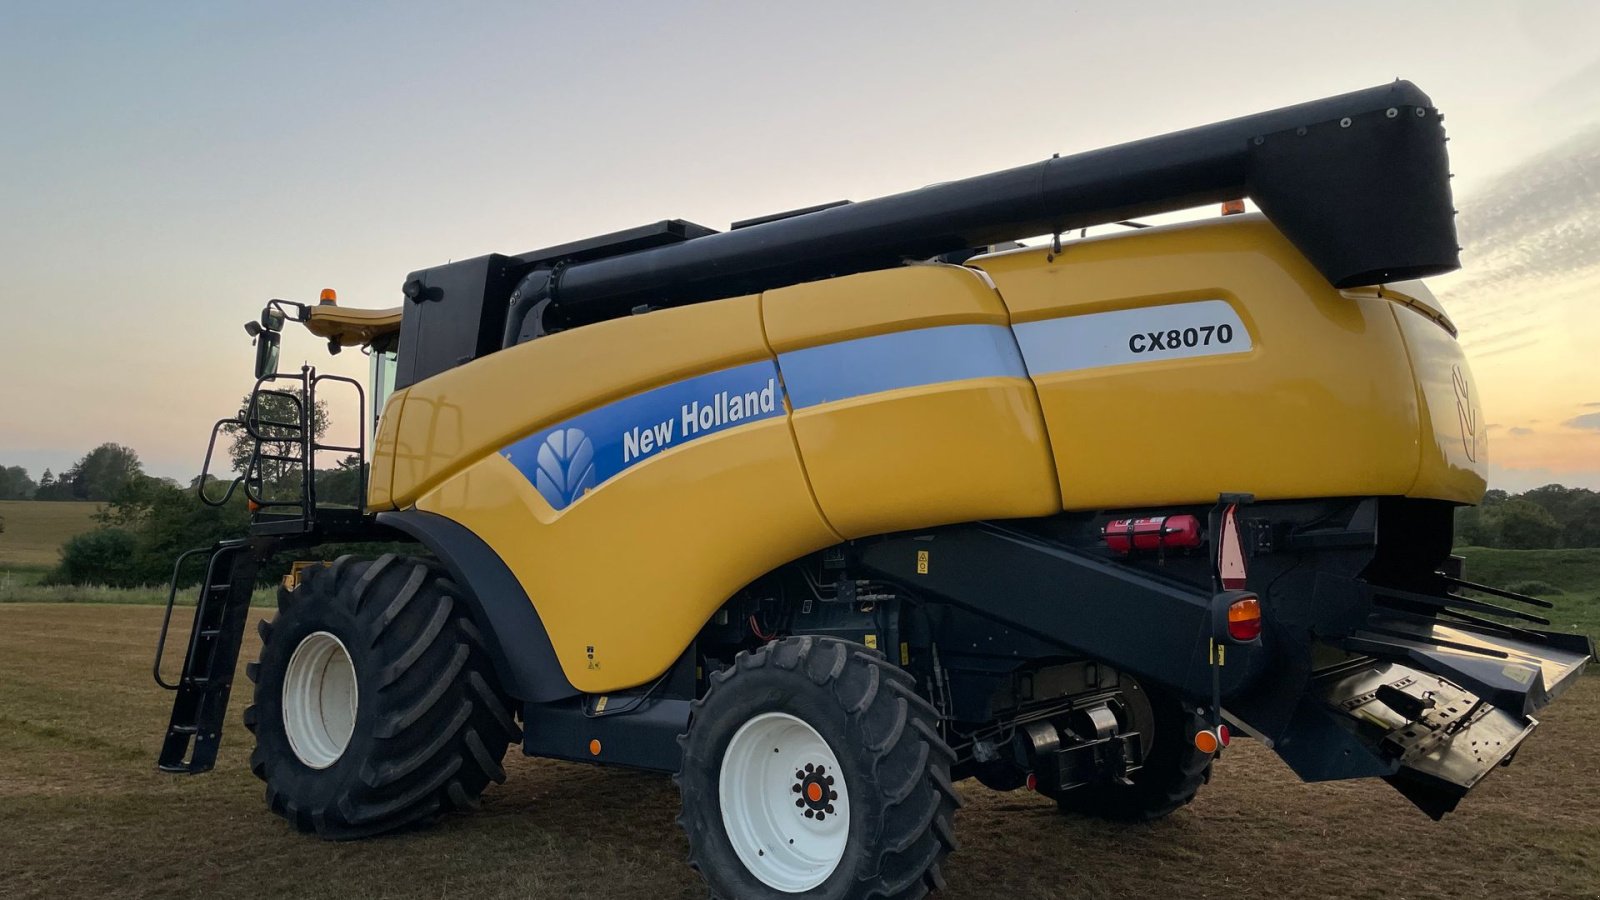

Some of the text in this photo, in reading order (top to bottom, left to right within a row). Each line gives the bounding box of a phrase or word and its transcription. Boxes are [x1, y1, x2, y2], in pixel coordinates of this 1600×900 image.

[1129, 324, 1232, 353] CX8070
[623, 378, 775, 463] New Holland
